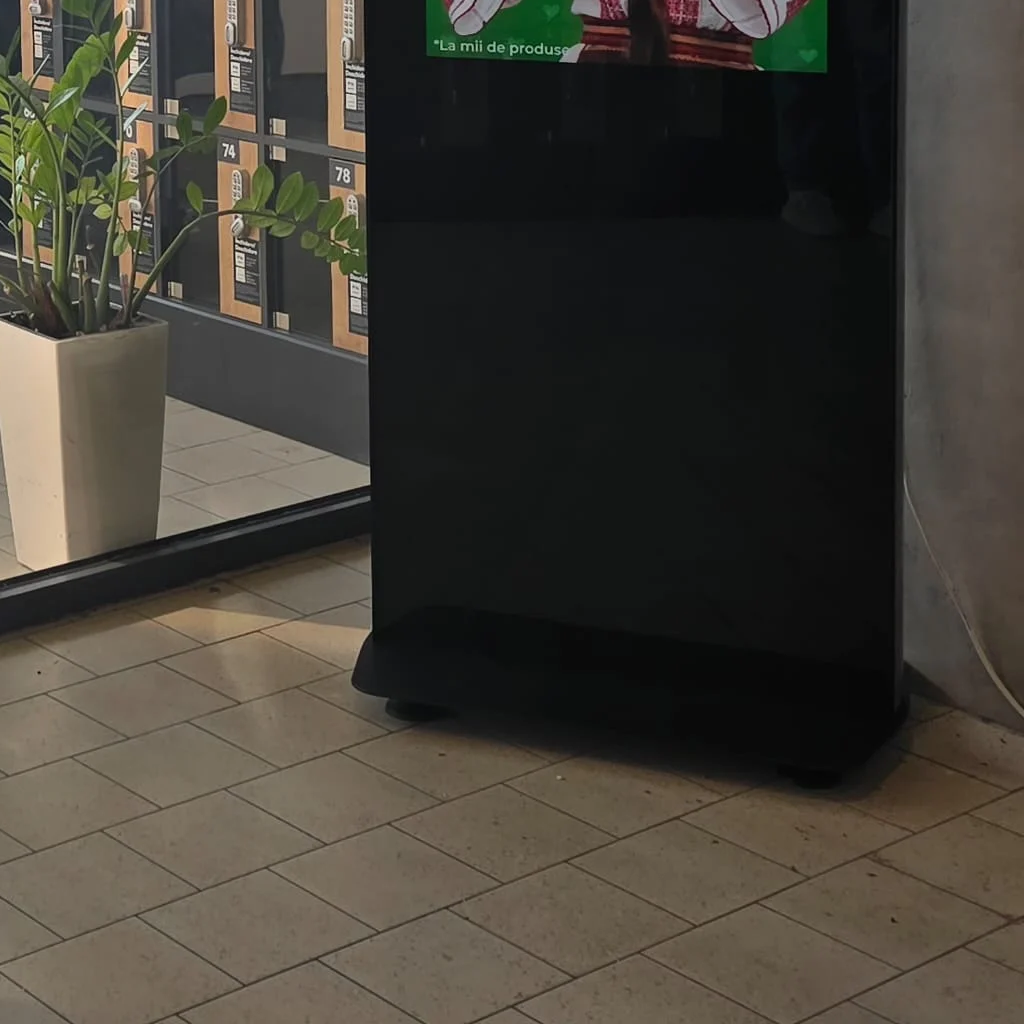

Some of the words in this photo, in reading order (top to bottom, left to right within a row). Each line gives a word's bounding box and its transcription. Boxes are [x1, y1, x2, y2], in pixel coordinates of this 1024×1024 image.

[461, 40, 483, 52] mii
[487, 41, 505, 53] de
[223, 143, 236, 159] 74
[335, 166, 350, 184] 78
